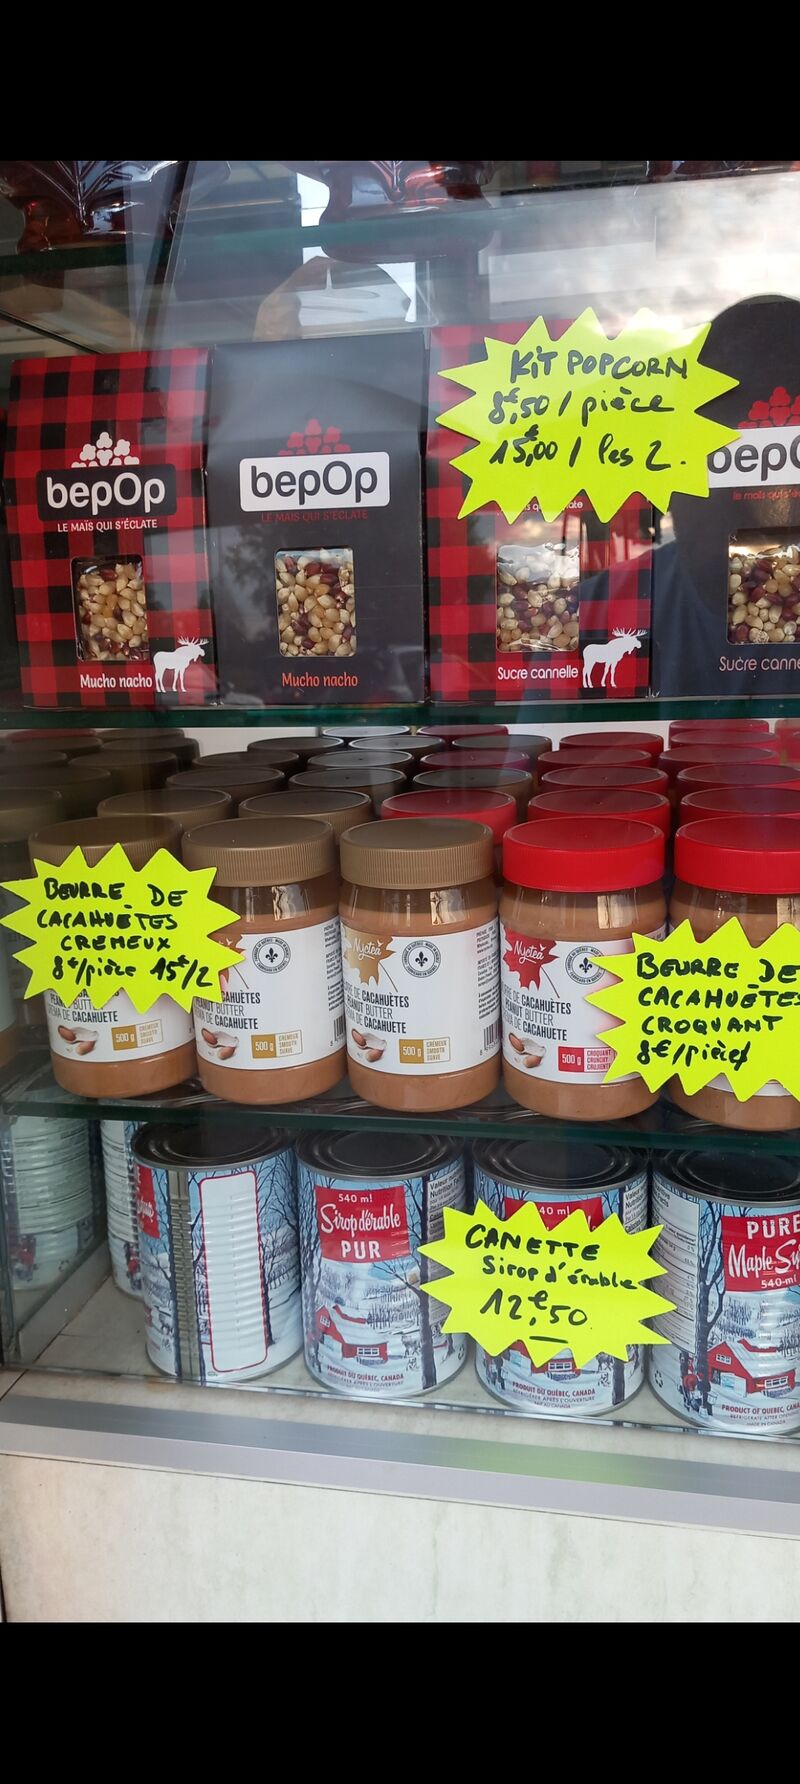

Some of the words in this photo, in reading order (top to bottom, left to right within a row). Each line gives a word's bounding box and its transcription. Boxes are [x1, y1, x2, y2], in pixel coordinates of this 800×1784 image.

[568, 350, 687, 380] POPCORN
[582, 386, 674, 427] pièce
[599, 433, 634, 467] les
[251, 461, 378, 505] bepOp
[46, 472, 166, 515] bepOp
[58, 523, 68, 532] LE
[70, 520, 94, 532] MAÏS
[96, 521, 112, 532] QUI
[115, 519, 158, 530] S'ÉCLATE
[720, 656, 758, 671] Sucre
[80, 674, 116, 689] Mucho
[120, 674, 152, 688] nacho
[282, 672, 320, 687] Mucho
[323, 673, 358, 686] nacho
[498, 667, 528, 680] Sucre
[530, 666, 578, 678] cannelle
[44, 878, 124, 900] BEURRE
[147, 884, 188, 906] DE
[637, 952, 740, 980] BEURRE
[759, 958, 800, 984] DE
[222, 990, 260, 1004] CAHUÈTES
[362, 990, 409, 1008] CACAHUÈTES
[522, 994, 571, 1015] CACAHUÈTES
[216, 1004, 244, 1016] BUTTER
[346, 994, 364, 1013] PEANUT
[366, 1004, 393, 1020] BUTTER
[505, 998, 522, 1018] PEANUT
[525, 1008, 553, 1026] BUTTER
[72, 1010, 118, 1023] CACAHUETE
[214, 1014, 258, 1030] CACAHUETE
[364, 1016, 406, 1034] CACAHUETE
[642, 1014, 783, 1036] CROQUANT
[116, 1032, 129, 1043] 500
[522, 1020, 567, 1041] CACAHUETE
[256, 1041, 268, 1051] 500
[402, 1046, 416, 1056] 500
[562, 1054, 575, 1064] 500
[338, 1194, 357, 1203] 540
[360, 1194, 372, 1203] ml
[557, 1206, 570, 1216] ml
[320, 1204, 358, 1238] Sirop
[359, 1204, 401, 1232] d'érable
[747, 1214, 800, 1240] PURE
[340, 1240, 381, 1260] PUR
[465, 1224, 600, 1261] CANETTE
[482, 1255, 539, 1281] Sirop
[728, 1244, 774, 1278] Maple
[381, 1373, 404, 1381] CANADA
[512, 1381, 536, 1393] PRODUIT
[537, 1387, 545, 1395] DU
[572, 1388, 596, 1397] CANADA
[722, 1404, 750, 1414] PRODUCT
